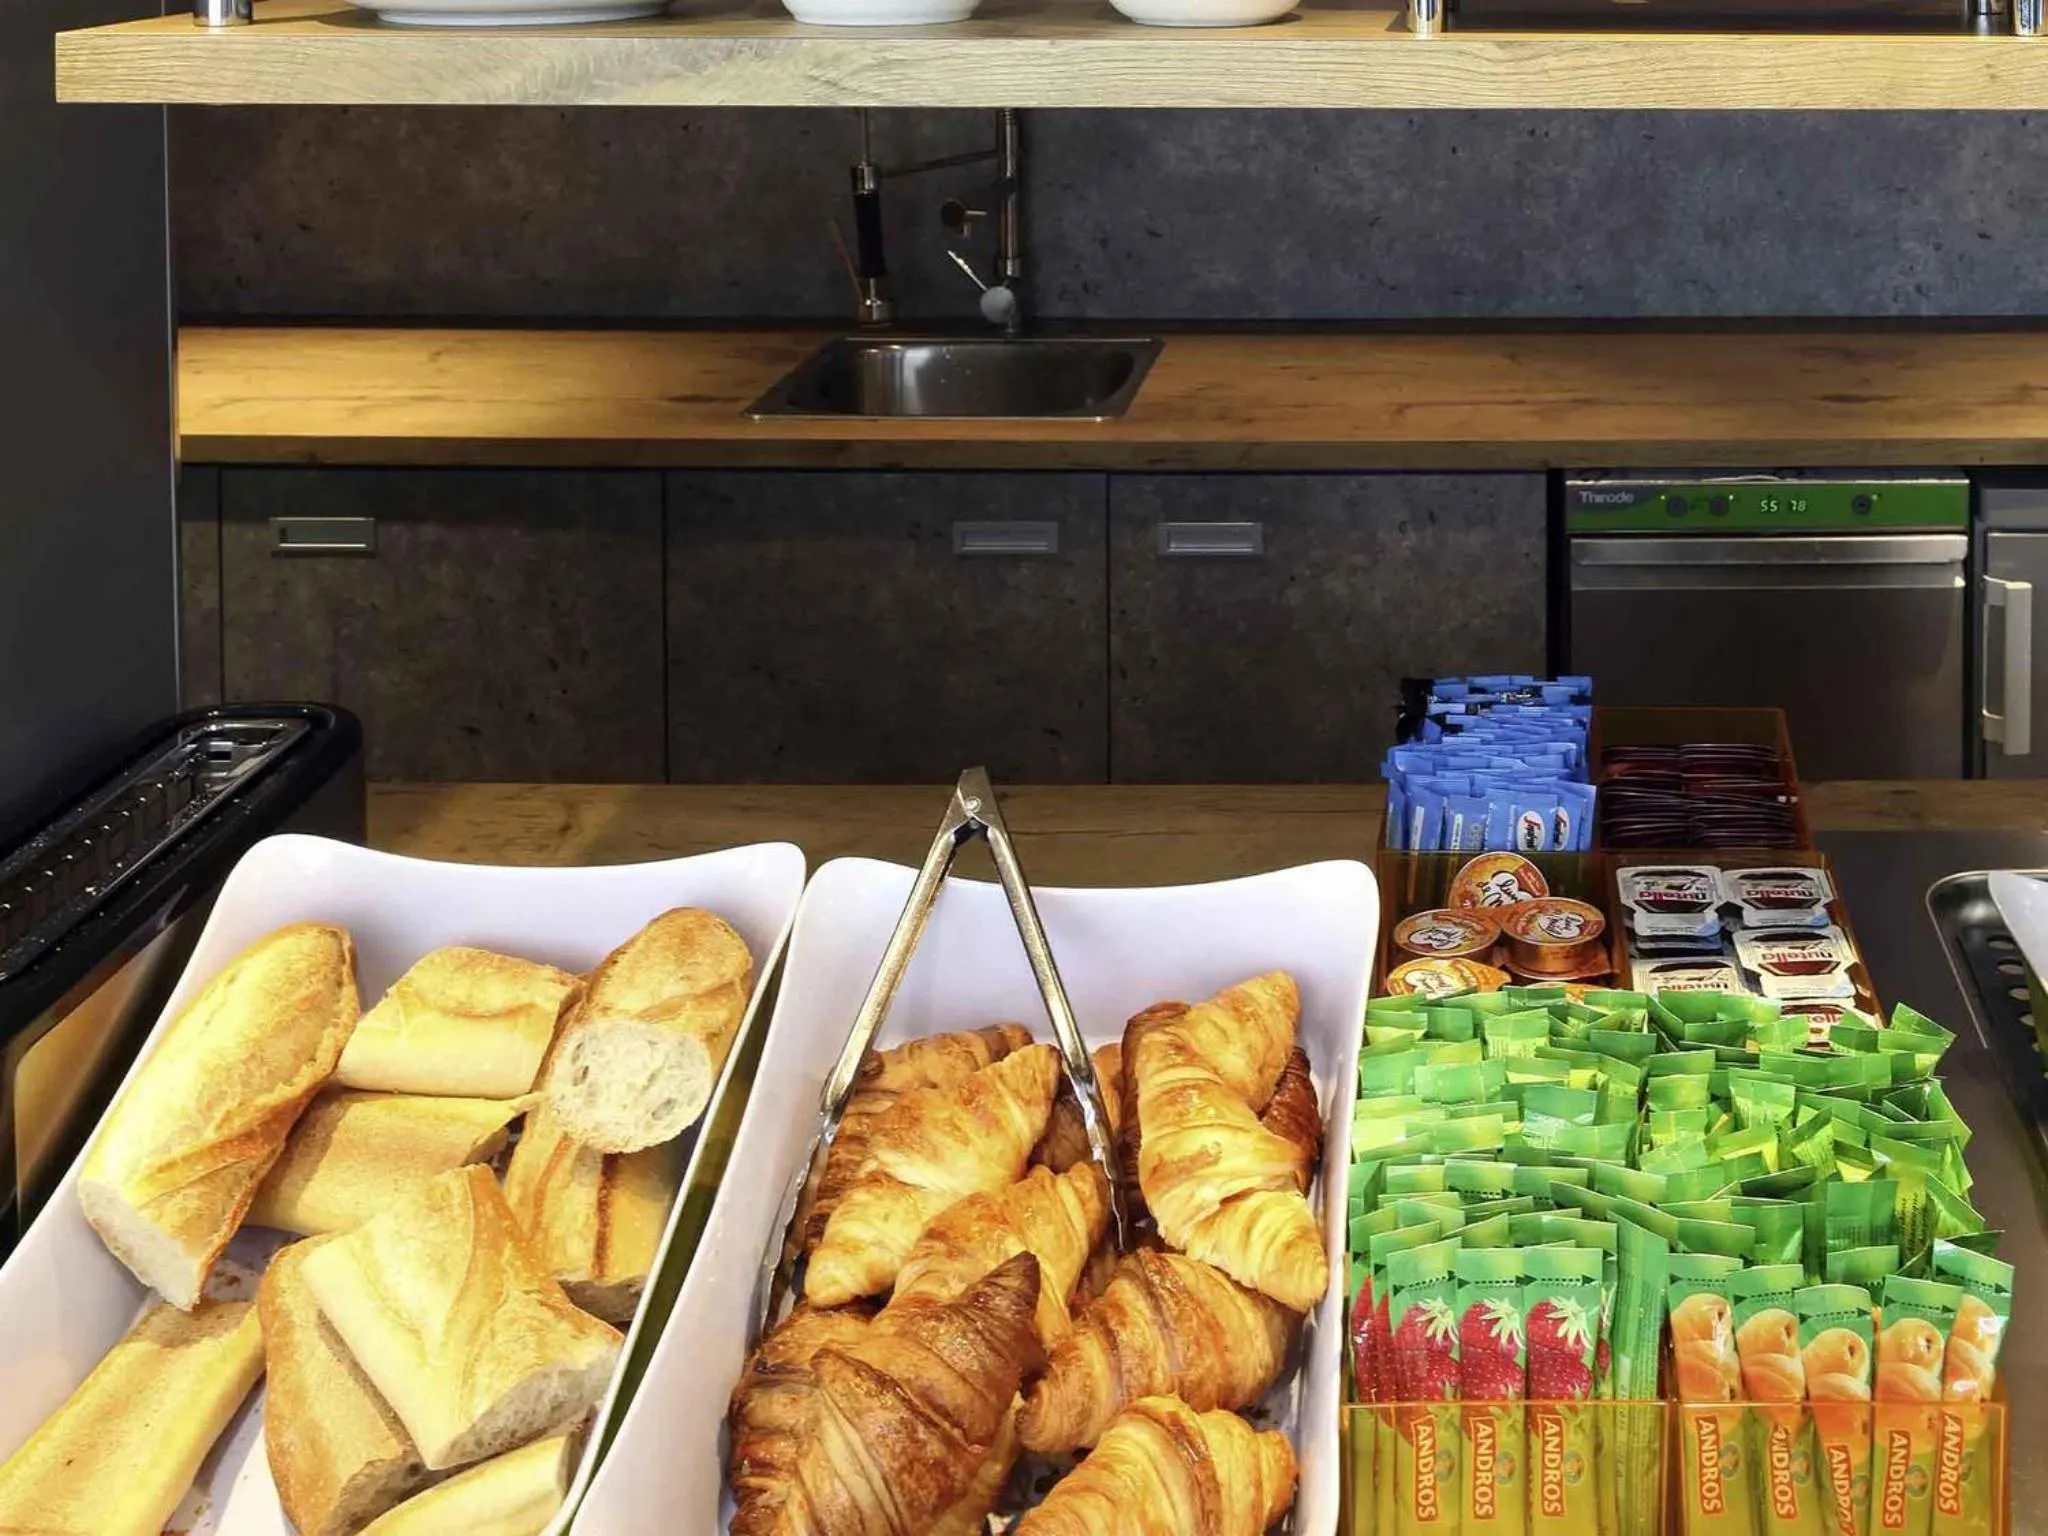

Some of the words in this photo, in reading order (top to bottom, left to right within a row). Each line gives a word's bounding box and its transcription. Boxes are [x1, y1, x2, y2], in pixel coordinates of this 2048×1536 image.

[1638, 891, 1707, 902] nutella
[1761, 950, 1833, 962] nutella
[1417, 1425, 1436, 1518] ANDROS
[1475, 1422, 1494, 1516] ANDROS
[1543, 1419, 1562, 1513] ANDROS
[1698, 1420, 1722, 1512] ANDROS
[1885, 1432, 1908, 1525] ANDROS
[1938, 1416, 1962, 1512] ANDROS
